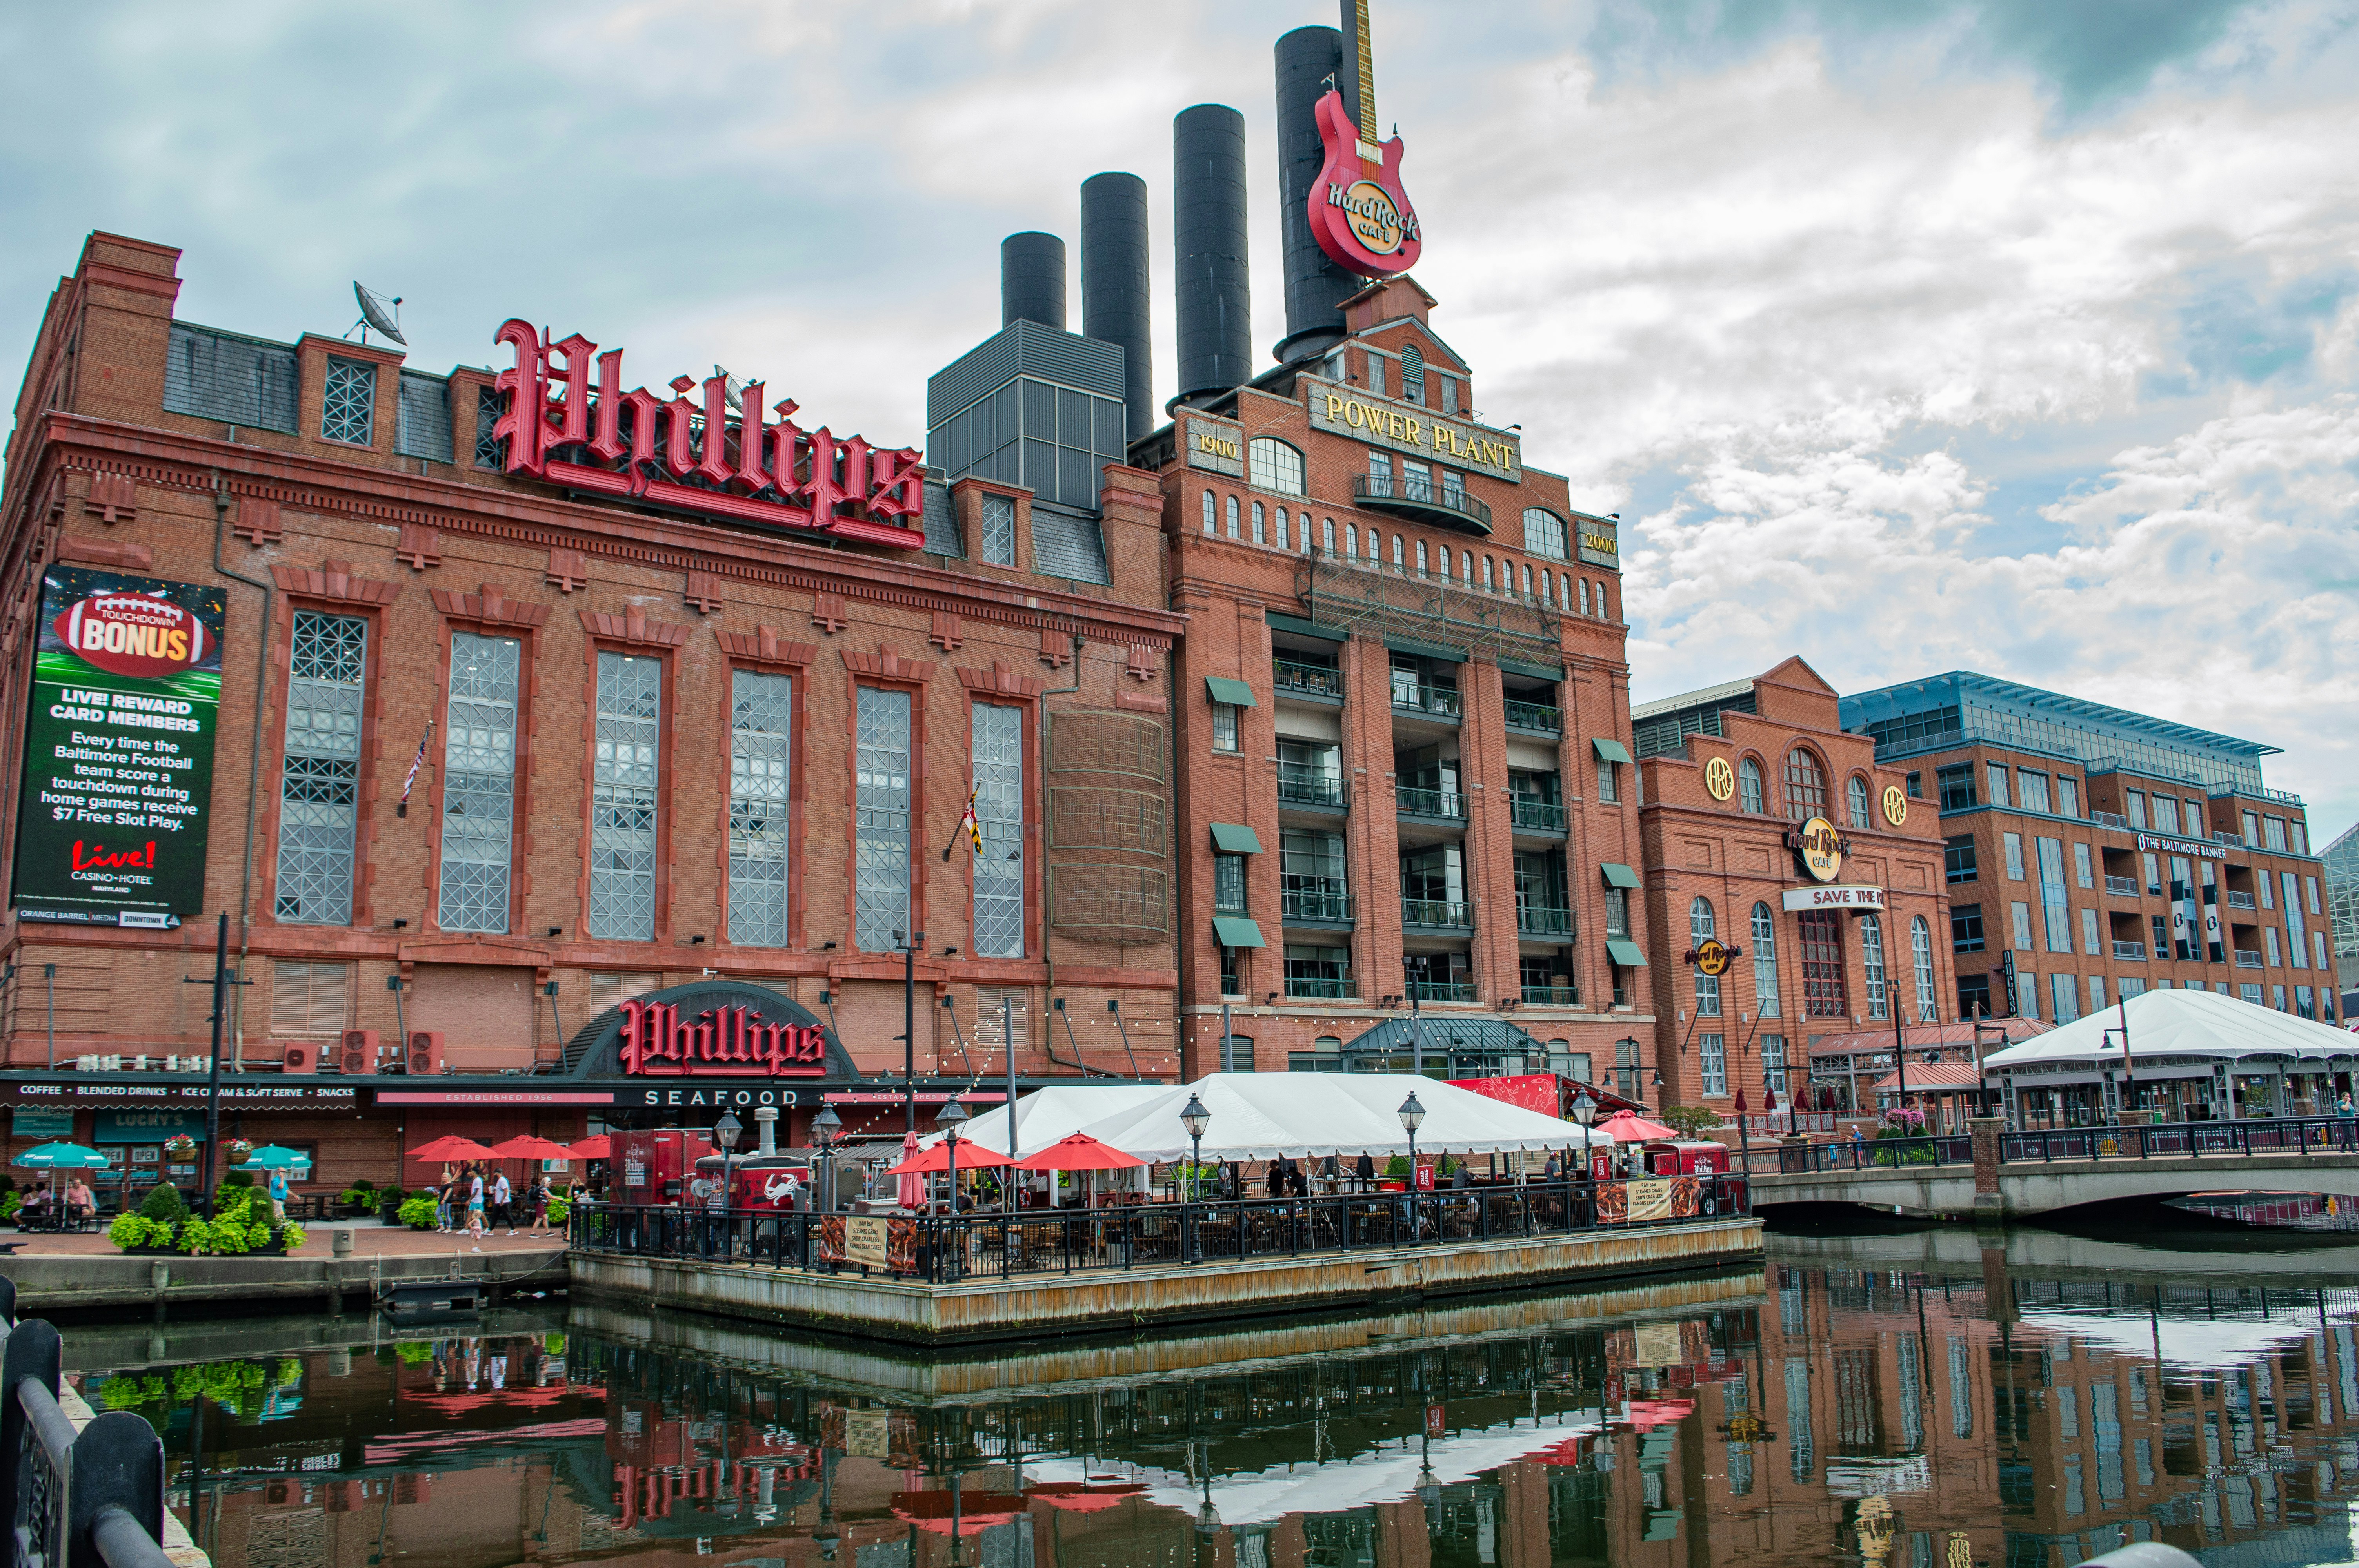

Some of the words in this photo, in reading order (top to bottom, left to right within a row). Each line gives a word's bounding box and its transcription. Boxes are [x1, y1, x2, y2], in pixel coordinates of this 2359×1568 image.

[1327, 182, 1373, 219] Hard
[1376, 199, 1418, 241] Rock
[1359, 223, 1390, 243] CAFE
[493, 318, 925, 550] Phillips
[1325, 394, 1421, 446] POWER
[1432, 425, 1513, 470] PLANT
[1200, 434, 1236, 458] 1900
[1586, 533, 1616, 553] 2000
[101, 610, 176, 627] TOUCHDOWN
[82, 619, 188, 661] BONUS
[62, 689, 109, 706] LIVE!
[112, 694, 193, 715] REWARD
[50, 705, 105, 722] CARD
[108, 711, 200, 732] MEMBERS
[71, 731, 115, 749] Every
[118, 737, 152, 750] time
[154, 740, 180, 753] the
[55, 745, 129, 764] Baltimore
[132, 753, 193, 769] Football
[74, 763, 114, 777] team
[116, 769, 159, 782] score
[161, 773, 171, 782] a
[52, 777, 138, 795] touchdown
[141, 784, 190, 802] during
[41, 791, 86, 806] home
[88, 797, 140, 810] games
[143, 802, 198, 815] receive
[53, 806, 75, 821] $7
[76, 809, 113, 823] Free
[115, 812, 147, 826] Slot
[148, 815, 184, 832] Play.
[1788, 824, 1819, 850] Hard
[1821, 828, 1851, 860] Rock
[2145, 837, 2160, 849] THE
[2161, 839, 2200, 855] BALTIMORE
[2200, 846, 2226, 859] BANNER
[72, 840, 156, 871] Live!
[1813, 856, 1832, 869] CAFE
[1814, 890, 1850, 904] SAVE
[1856, 890, 1875, 902] THE
[20, 910, 57, 918] ORANGE
[619, 999, 826, 1076] Phillips
[20, 1085, 62, 1094] COFFEE
[76, 1086, 127, 1095] BLENDED
[127, 1087, 168, 1096] DRINKS
[182, 1087, 199, 1096] ICE
[199, 1088, 234, 1097] CAM
[236, 1088, 245, 1096] &
[245, 1089, 273, 1097] SOFT
[273, 1089, 304, 1097] SERVE
[316, 1088, 355, 1097] SNACKS
[645, 1091, 797, 1105] SEAFOOD
[115, 1114, 184, 1126] LUCKY'S
[136, 1151, 155, 1160] OPEN
[1694, 1165, 1713, 1175] Phillips
